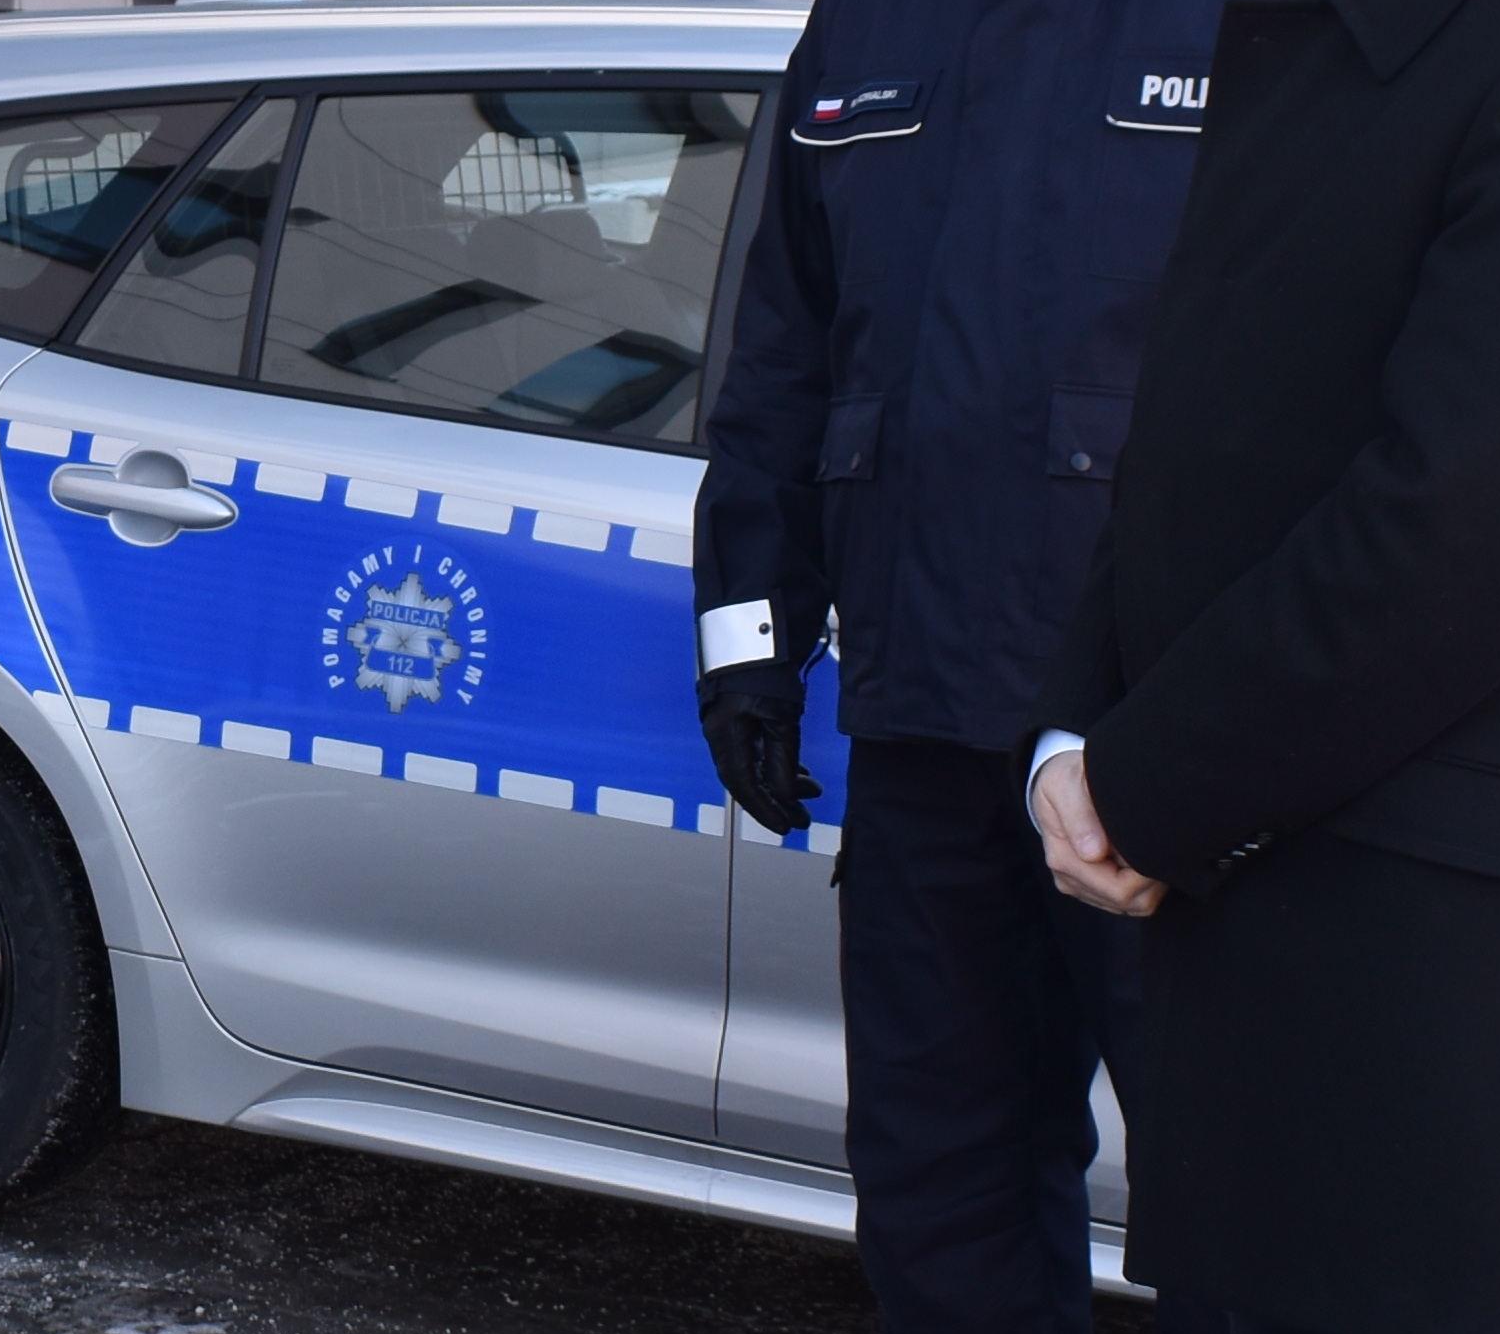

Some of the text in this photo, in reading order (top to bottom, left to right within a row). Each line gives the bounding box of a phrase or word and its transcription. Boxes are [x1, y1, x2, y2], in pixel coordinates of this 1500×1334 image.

[1140, 74, 1210, 109] POLI
[322, 544, 487, 705] POMAGAMY I CHRONIMY
[373, 603, 441, 628] POLICJA
[388, 655, 414, 674] 112
